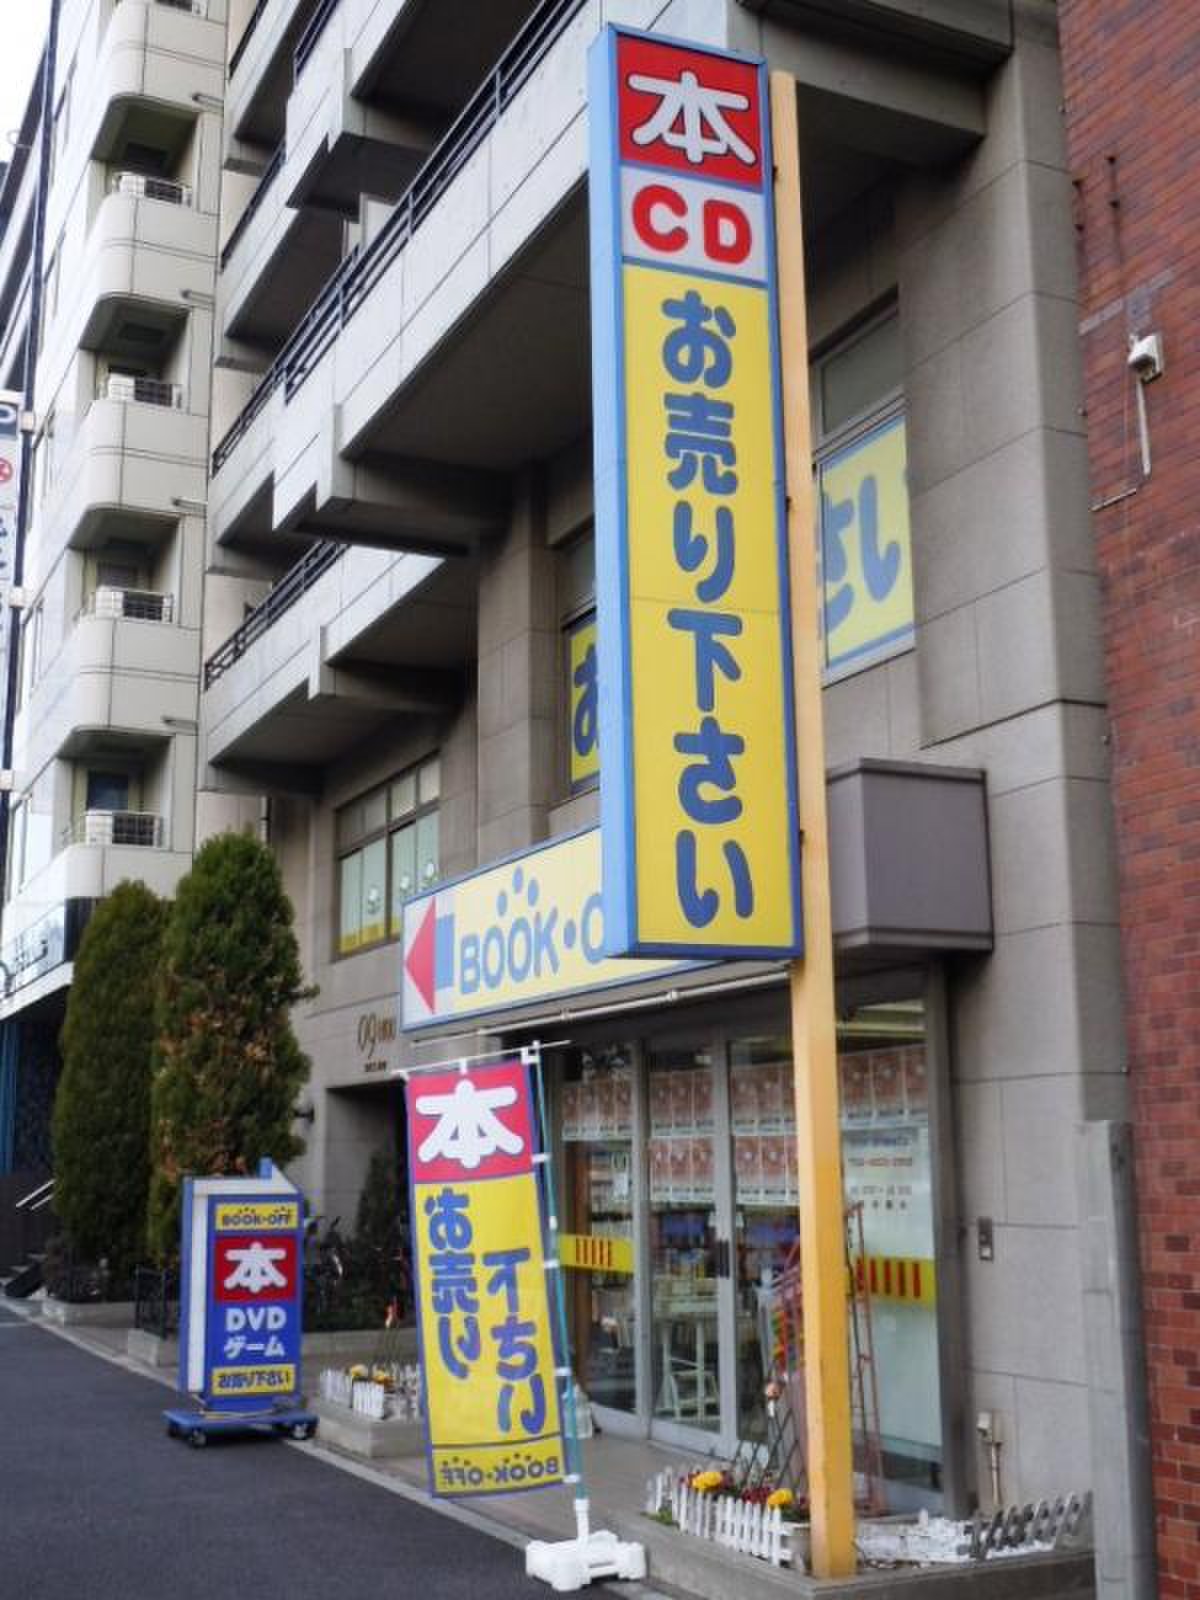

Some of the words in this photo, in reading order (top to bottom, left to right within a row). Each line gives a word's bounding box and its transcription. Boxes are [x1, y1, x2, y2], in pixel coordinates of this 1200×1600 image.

[627, 70, 757, 165] 本
[631, 184, 753, 266] CD
[661, 289, 755, 928] お売り下さい
[223, 1241, 288, 1294] 本
[223, 1335, 286, 1360] ゲーム
[225, 1306, 288, 1333] DVD
